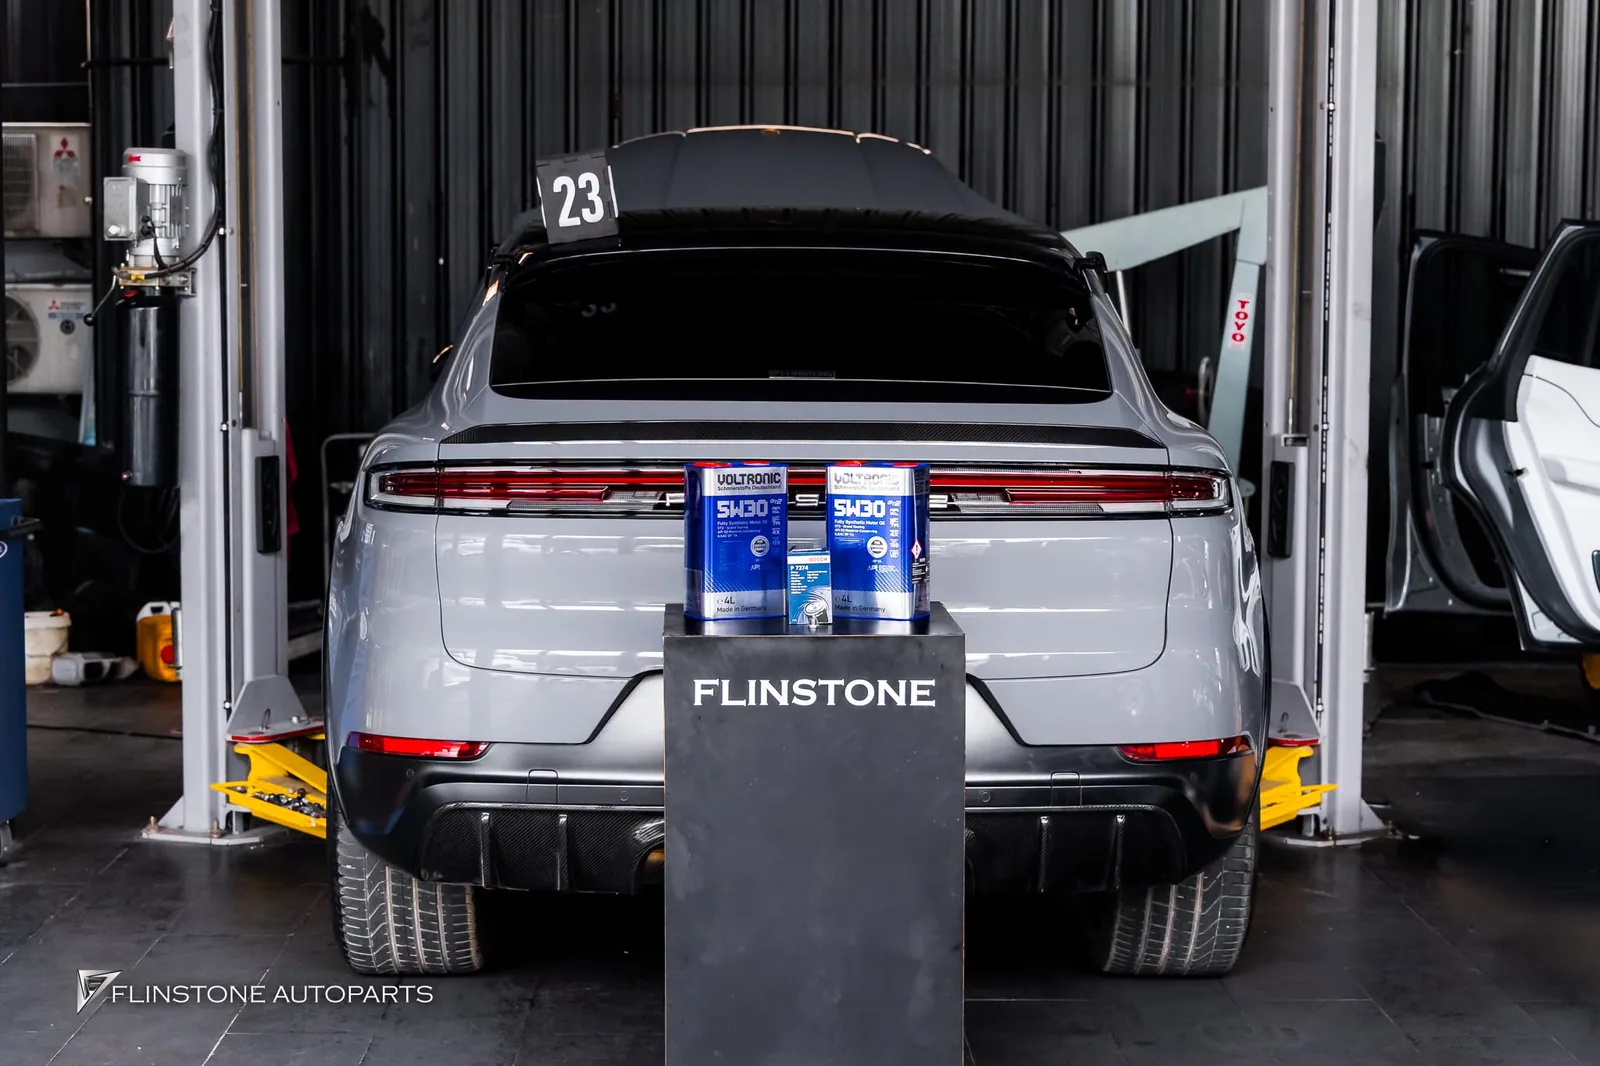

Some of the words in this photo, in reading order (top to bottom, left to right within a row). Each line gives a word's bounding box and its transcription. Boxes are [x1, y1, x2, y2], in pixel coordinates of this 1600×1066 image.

[553, 172, 604, 228] 23
[1231, 299, 1250, 342] TOYO
[717, 472, 781, 486] VOLTRONIC
[717, 499, 768, 519] 5W30
[834, 499, 886, 518] 5W30
[724, 596, 735, 604] 4L
[841, 595, 852, 603] 4L
[741, 605, 767, 613] Germany
[858, 605, 886, 613] Germany
[693, 678, 936, 707] FLINSTONE
